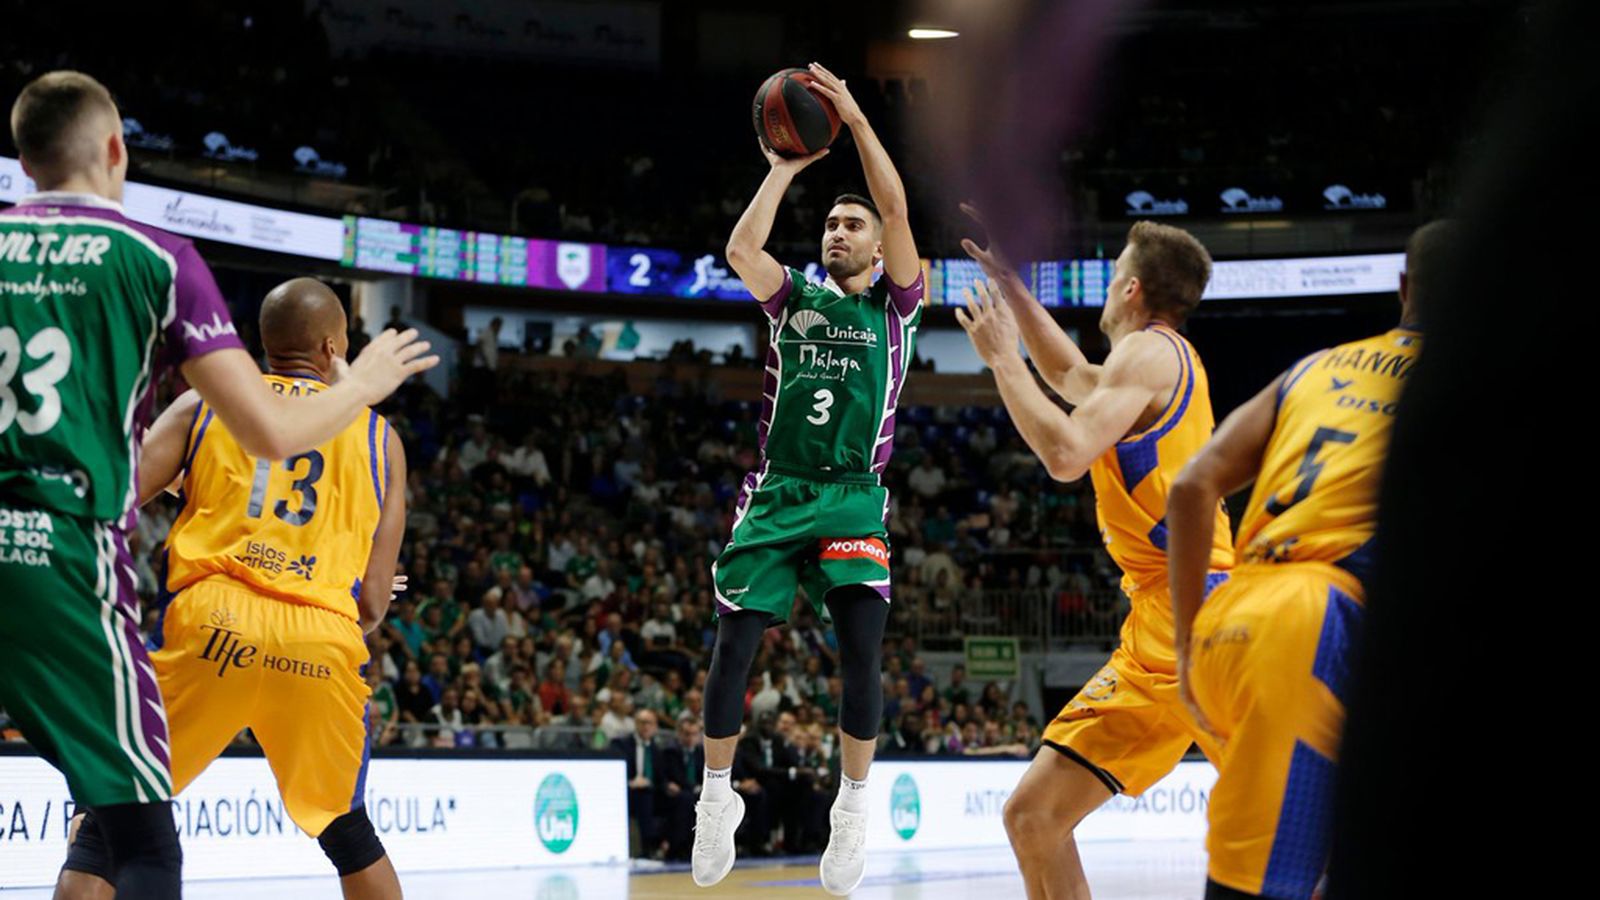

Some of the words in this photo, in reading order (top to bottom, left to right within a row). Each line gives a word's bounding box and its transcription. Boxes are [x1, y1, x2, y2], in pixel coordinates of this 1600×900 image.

[628, 253, 651, 287] 2
[826, 325, 878, 343] Unicaja
[806, 388, 835, 426] 3
[1265, 426, 1358, 518] 5
[247, 449, 325, 527] 13
[13, 529, 54, 551] SOL
[245, 540, 287, 563] Islas
[262, 653, 332, 680] HOTELES
